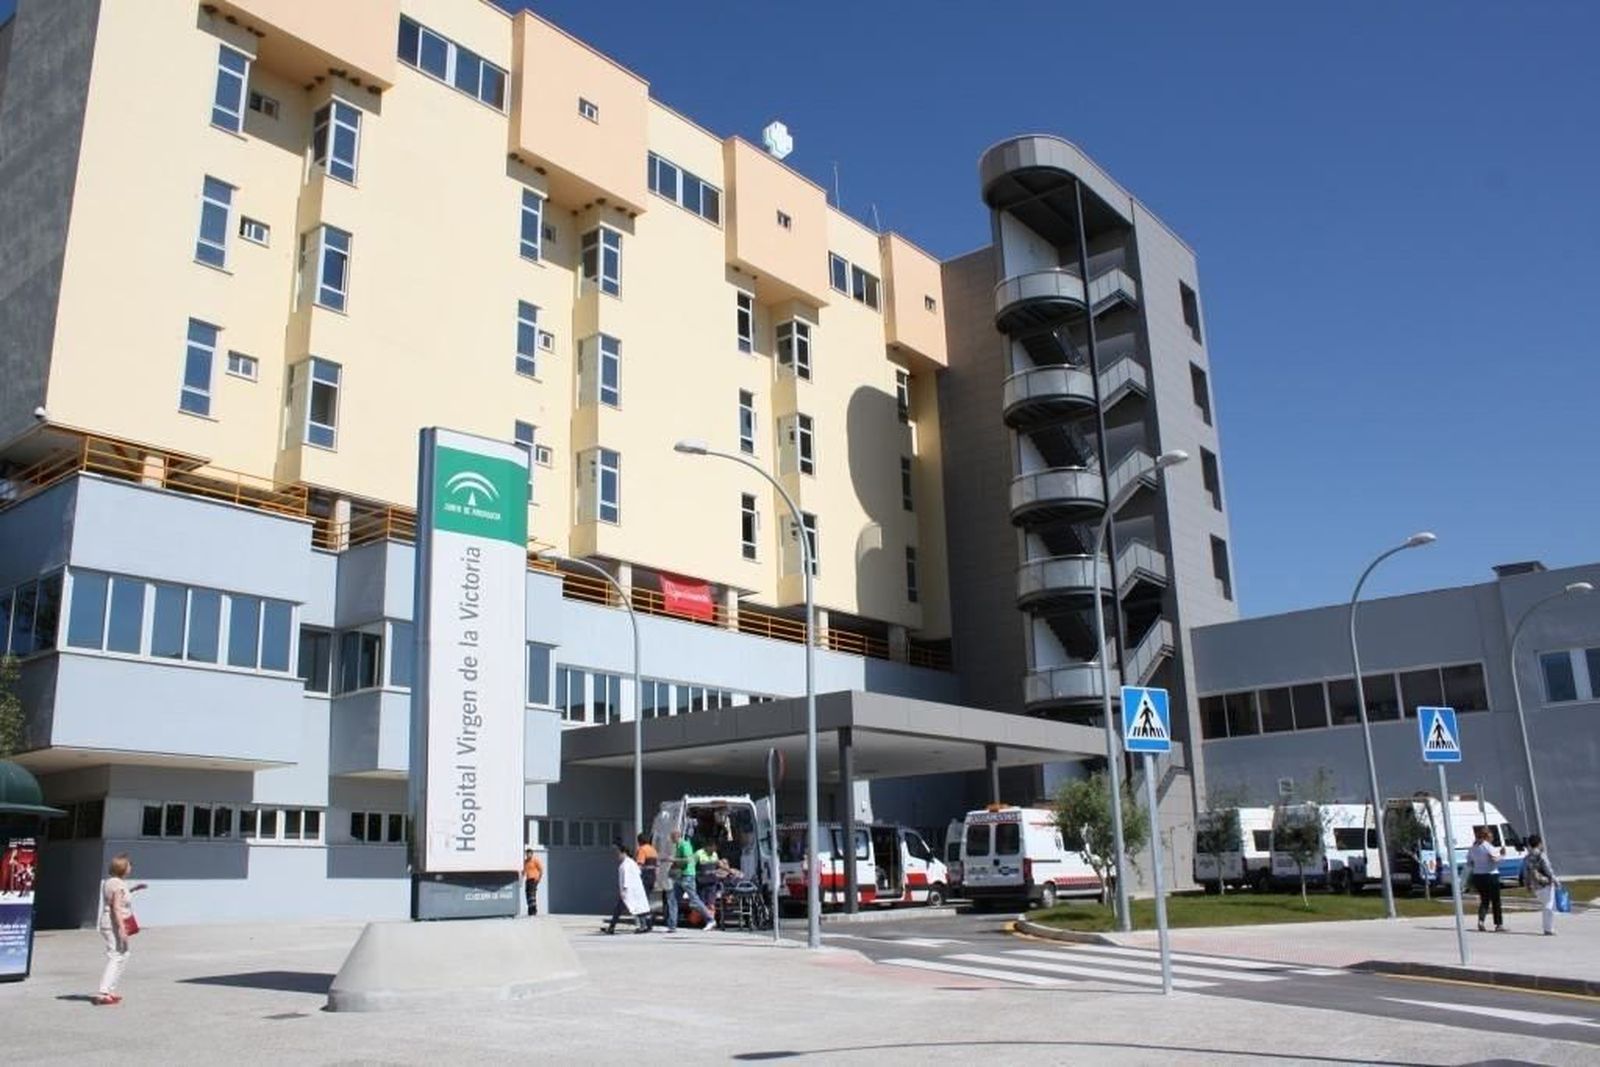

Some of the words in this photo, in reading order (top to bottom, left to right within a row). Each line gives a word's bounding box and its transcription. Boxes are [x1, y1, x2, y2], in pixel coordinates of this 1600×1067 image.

[459, 546, 482, 621] Victoria
[458, 630, 479, 648] la
[458, 656, 479, 682] de
[456, 690, 483, 756] Virgen
[455, 765, 482, 852] Hospital
